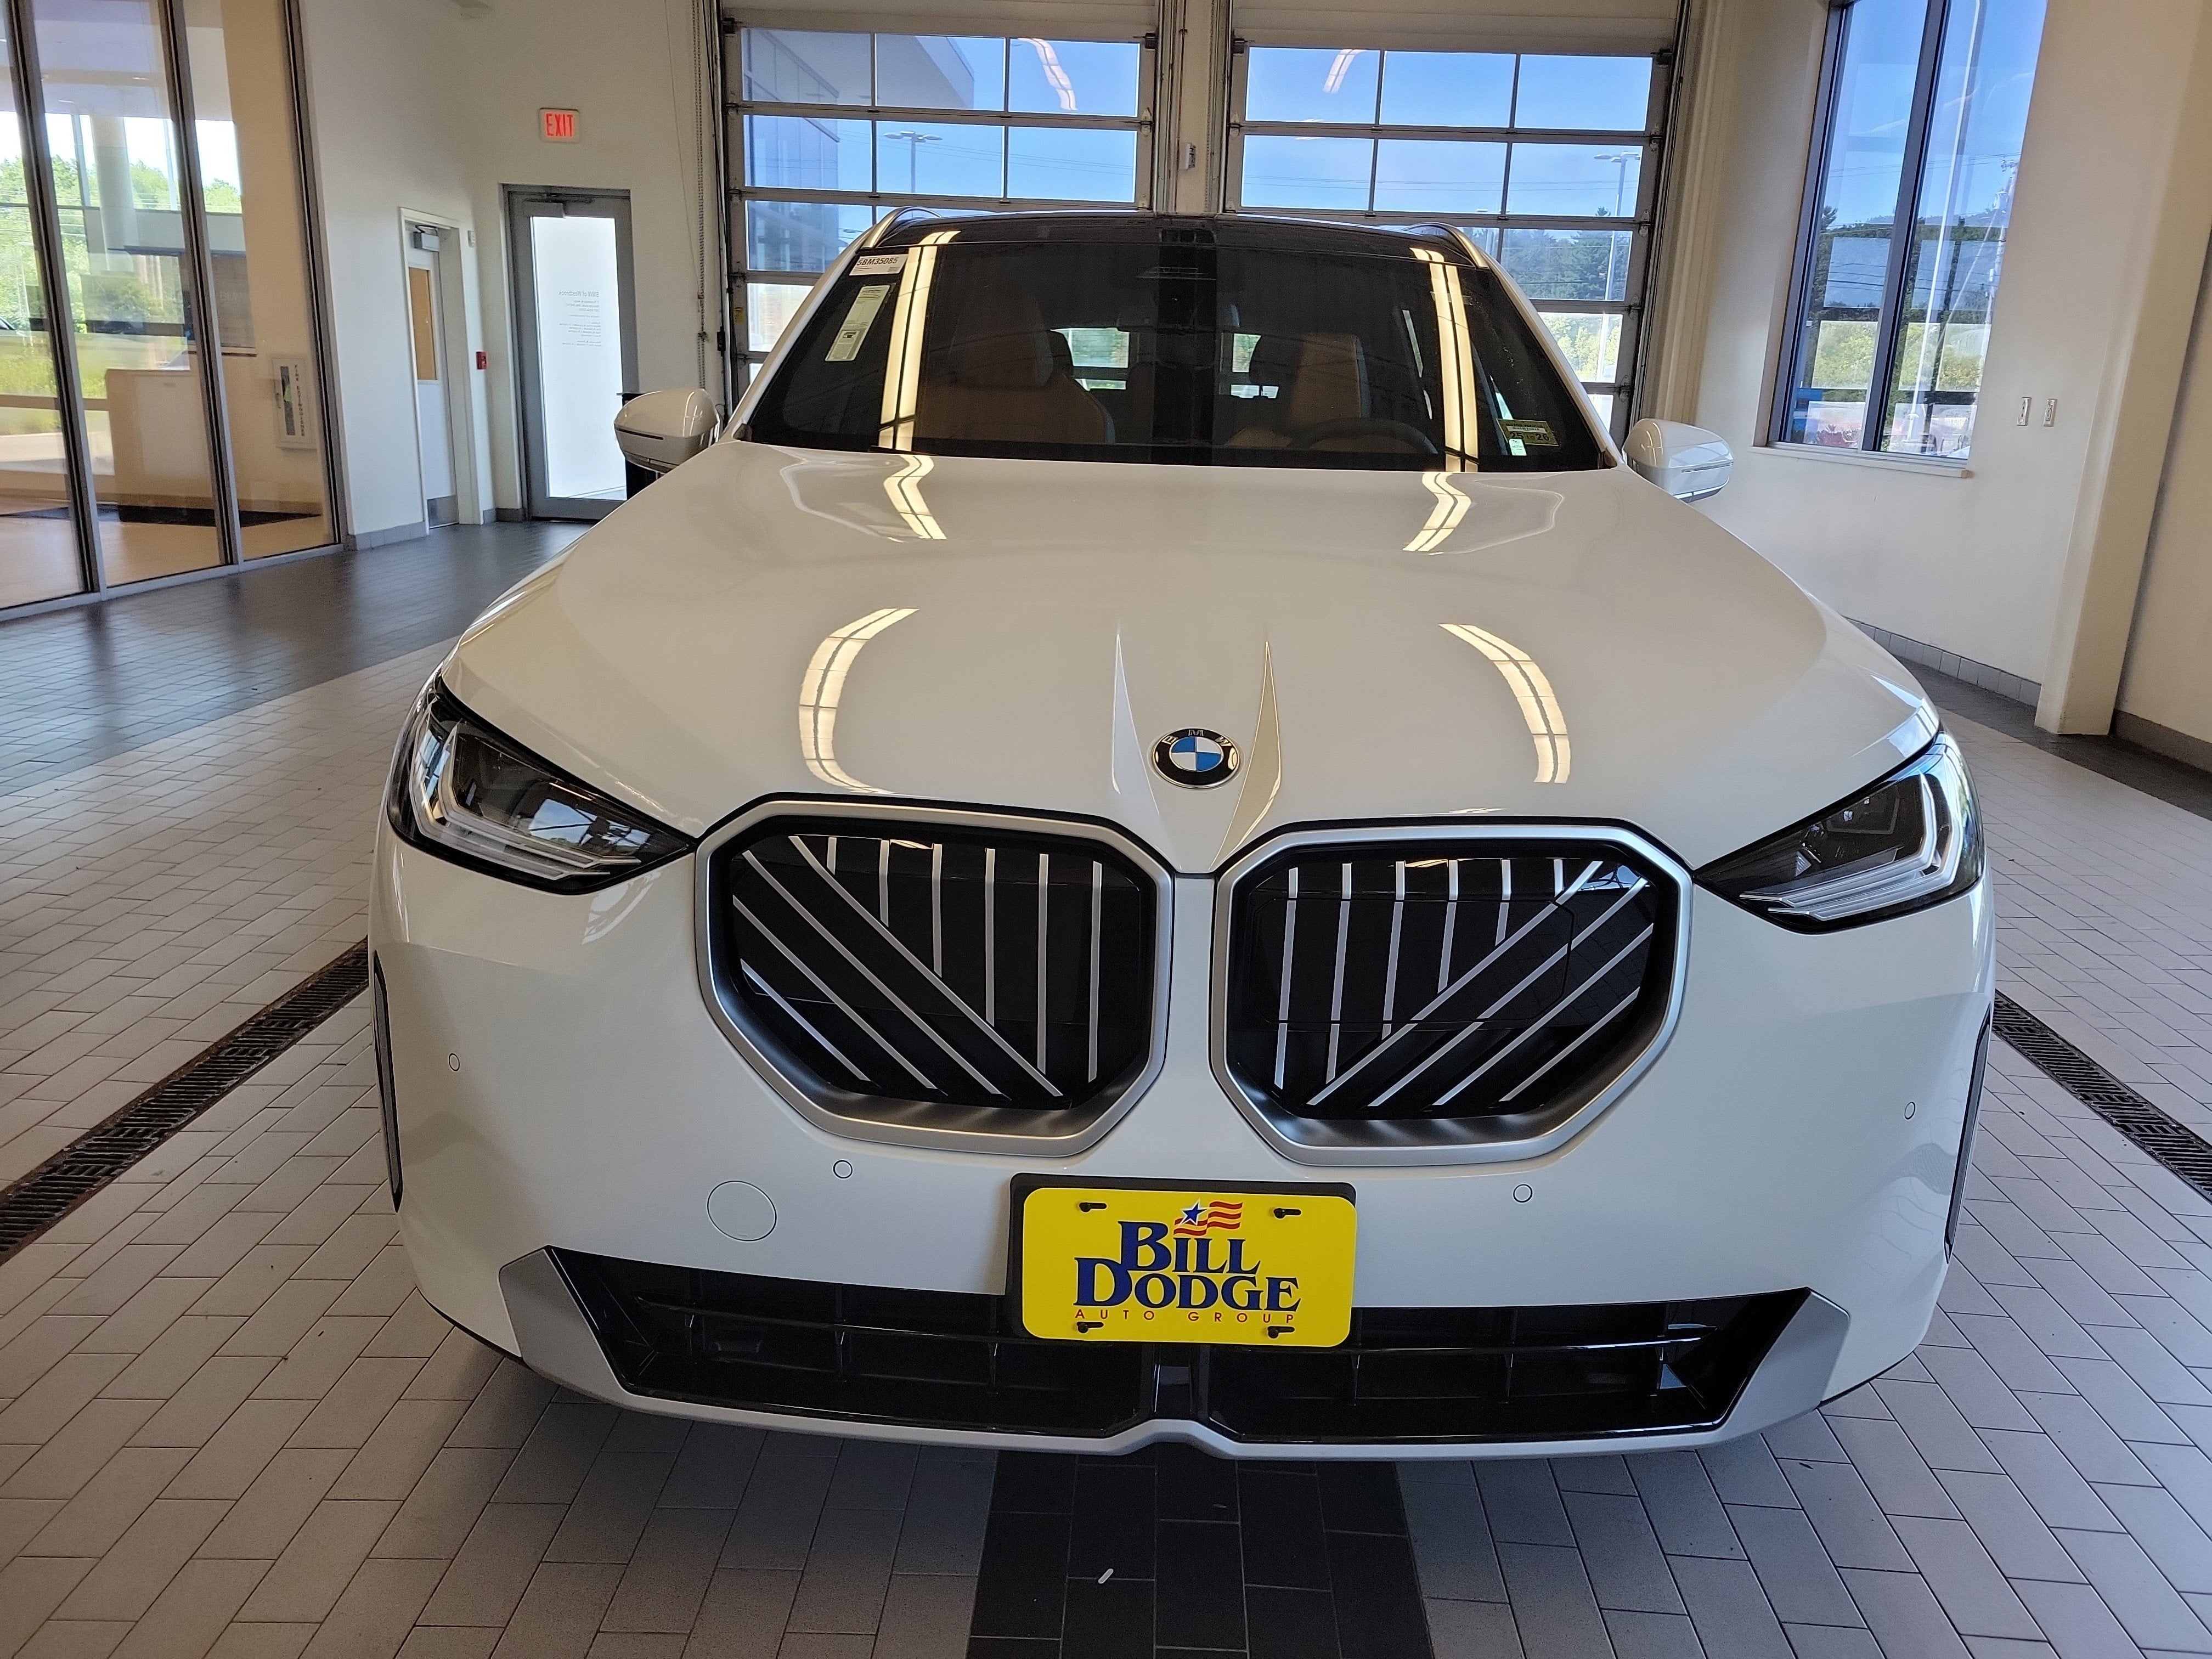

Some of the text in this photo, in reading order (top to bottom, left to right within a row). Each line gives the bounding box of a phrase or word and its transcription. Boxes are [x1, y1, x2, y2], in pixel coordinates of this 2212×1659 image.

[546, 113, 574, 137] EXIT
[856, 257, 899, 266] 5BM35085
[1161, 729, 1232, 747] BMW
[1118, 1221, 1261, 1276] BILL
[1073, 1257, 1301, 1312] DODGE
[1074, 1308, 1295, 1324] AUTO GROUP
